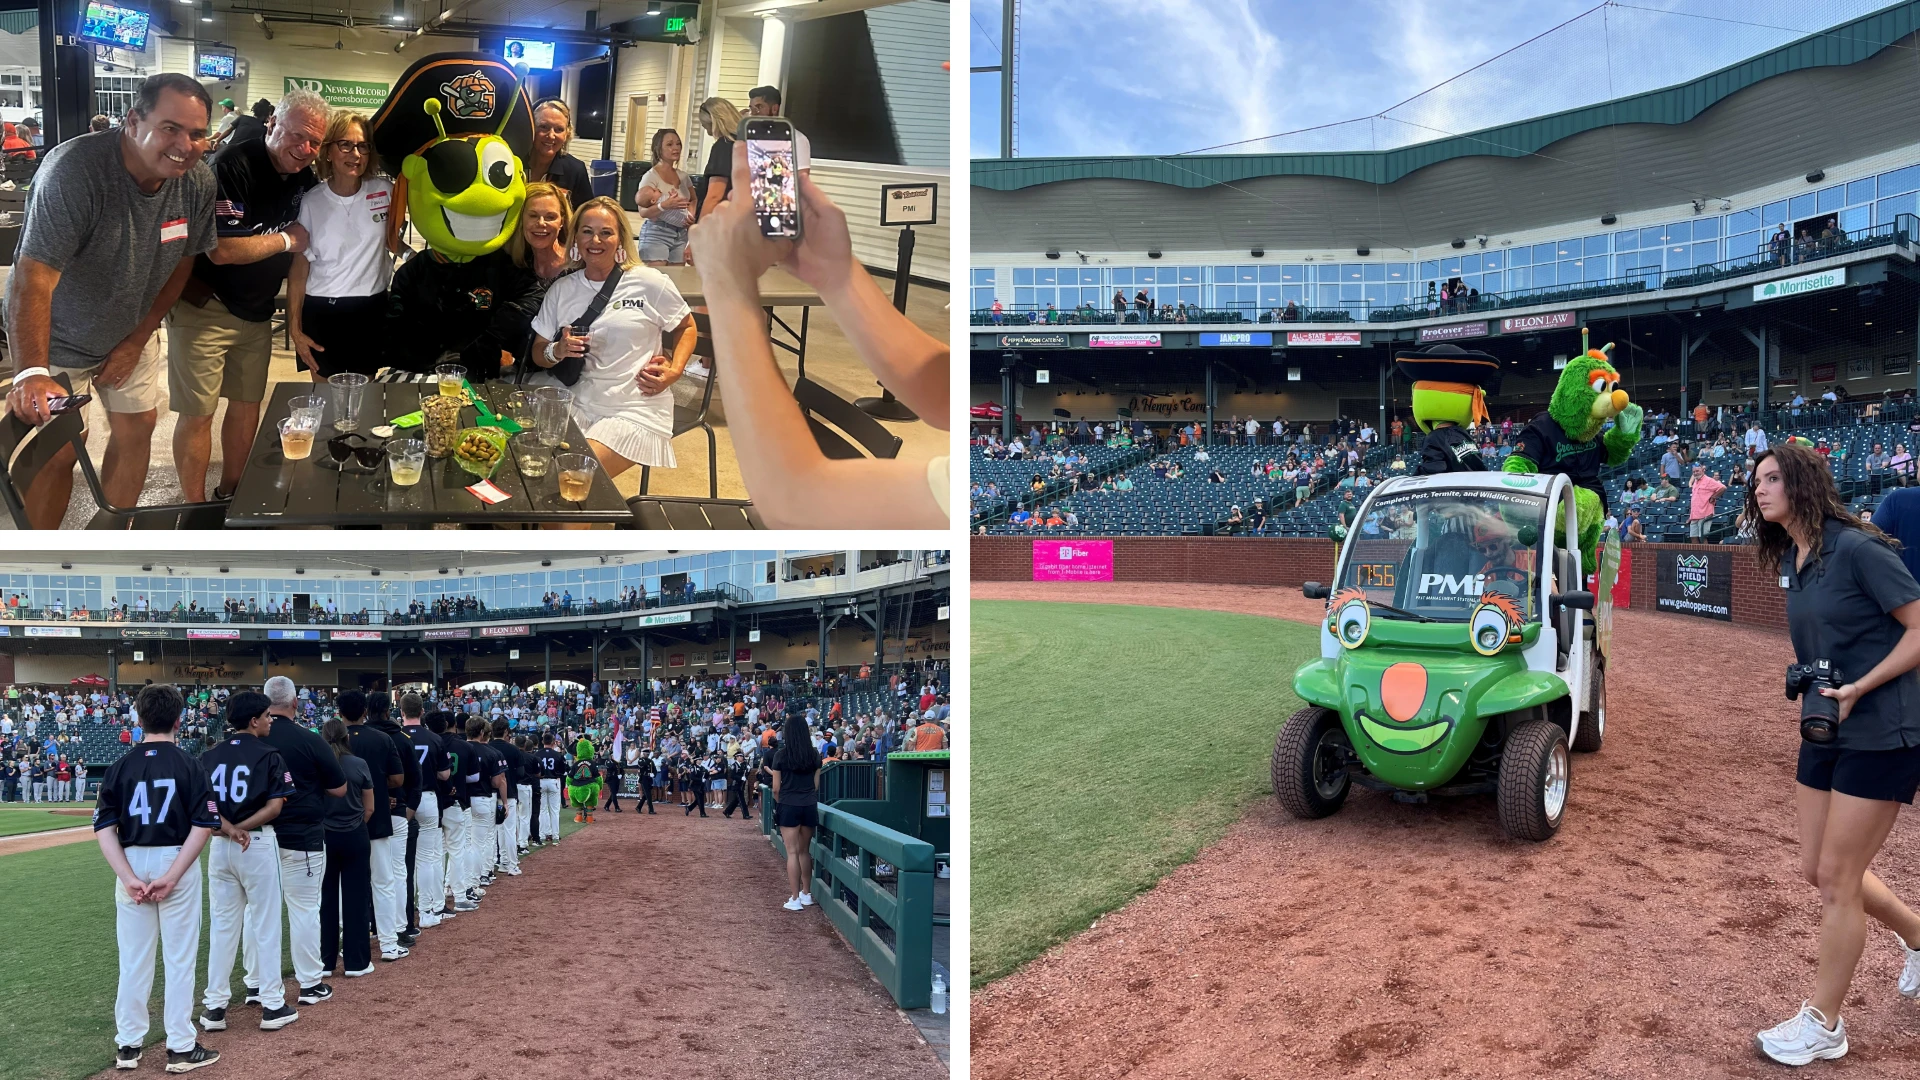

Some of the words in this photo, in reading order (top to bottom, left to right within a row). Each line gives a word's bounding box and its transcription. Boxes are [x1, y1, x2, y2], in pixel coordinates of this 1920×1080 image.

[667, 18, 684, 30] EXIT
[325, 84, 348, 94] NEWS
[355, 86, 387, 97] RECORD
[325, 95, 386, 105] greensboro.com
[1780, 275, 1834, 295] Morrisette
[621, 299, 644, 308] PMi
[1515, 316, 1544, 328] ELON
[1546, 314, 1568, 325] LAW
[1292, 332, 1326, 340] ALL-STATE
[1422, 327, 1464, 337] ProCover
[1142, 397, 1178, 418] Henry's
[1180, 397, 1207, 414] Corn
[1375, 496, 1410, 507] Complete
[1411, 492, 1429, 500] Pest,
[1431, 490, 1462, 498] Termite,
[1480, 491, 1510, 502] Wildlife
[1510, 496, 1540, 507] Control
[1072, 549, 1089, 557] Fiber
[1682, 572, 1702, 582] FIELD
[1418, 573, 1486, 596] PMi
[1659, 597, 1728, 615] www.gsohoppers.com
[654, 614, 686, 624] Morrisette
[489, 626, 509, 635] ELON
[509, 626, 525, 634] LAW
[210, 763, 251, 803] 46
[128, 778, 176, 825] 47
